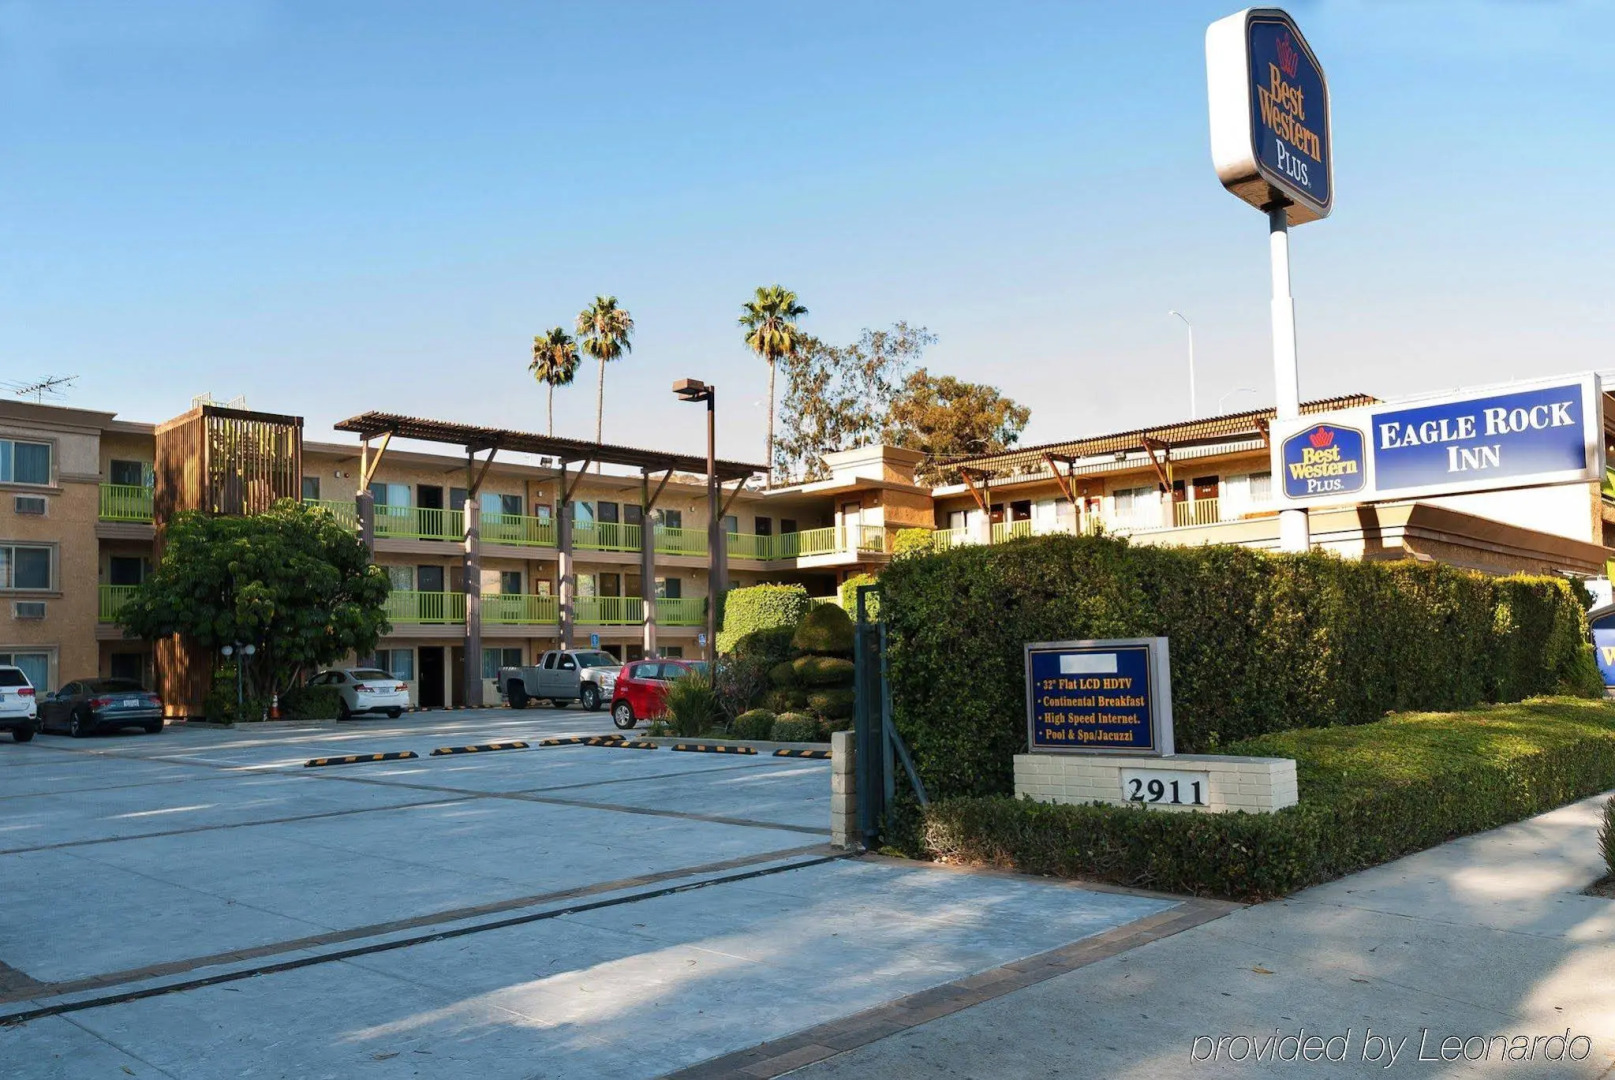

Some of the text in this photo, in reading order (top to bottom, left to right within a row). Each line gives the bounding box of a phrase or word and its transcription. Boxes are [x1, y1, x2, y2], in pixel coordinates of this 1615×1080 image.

[1268, 62, 1304, 121] Best
[1256, 84, 1321, 163] Western
[1276, 139, 1309, 186] PLUS
[1379, 401, 1575, 449] EAGLE ROCK
[1302, 444, 1340, 465] Best
[1447, 444, 1501, 473] INN
[1288, 460, 1358, 480] Western
[1307, 479, 1342, 493] PLUS
[1058, 679, 1078, 690] Flat
[1080, 678, 1100, 690] LCD
[1103, 678, 1132, 690] HDTV
[1043, 695, 1145, 707] Continental Breakfast
[1044, 712, 1066, 726] High
[1068, 713, 1096, 726] Speed
[1046, 729, 1133, 743] Pool & Spa/Jacuzzi
[1128, 778, 1205, 806] 2911
